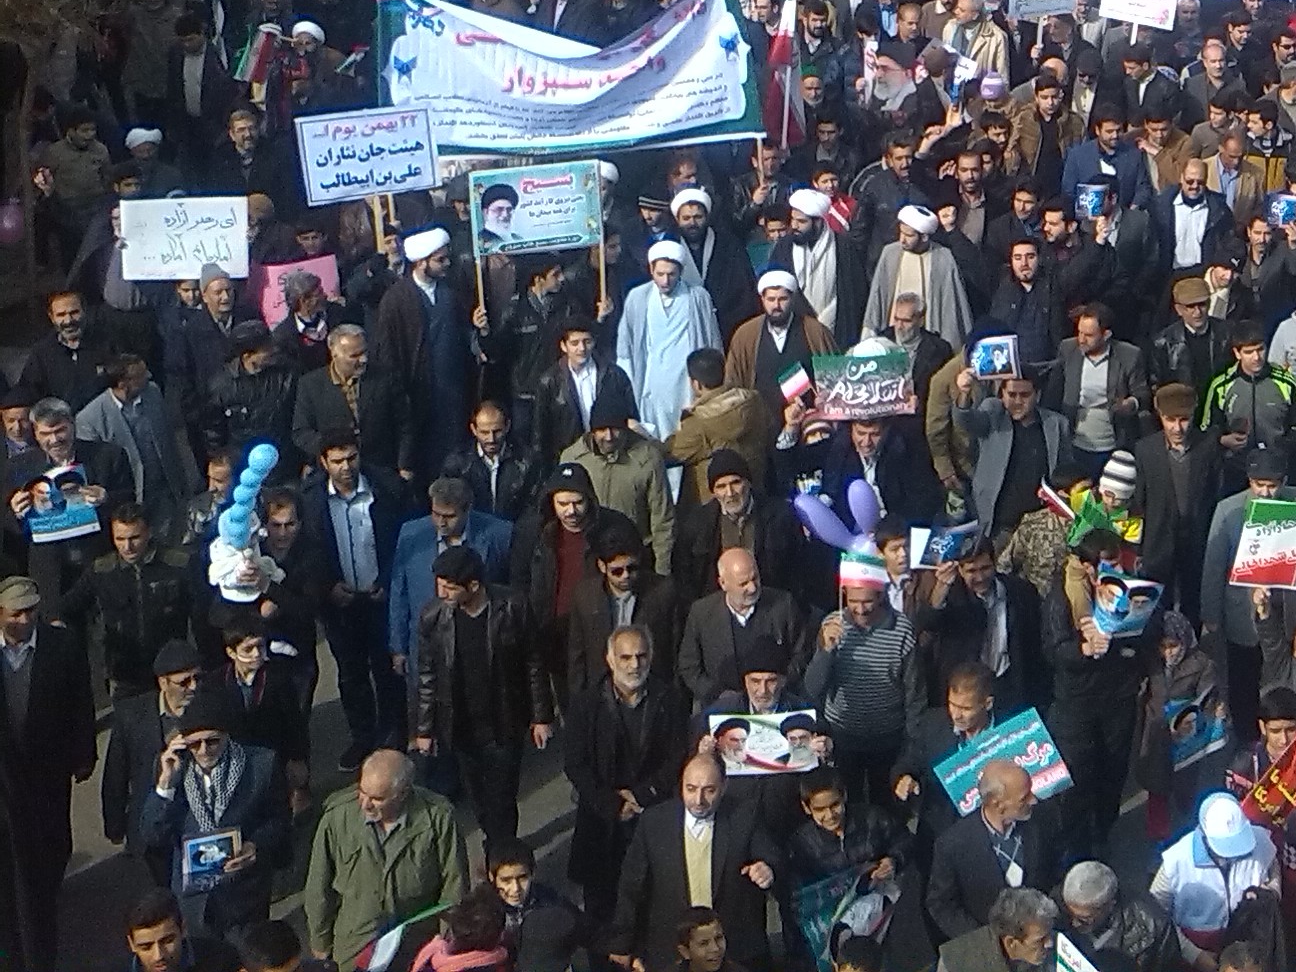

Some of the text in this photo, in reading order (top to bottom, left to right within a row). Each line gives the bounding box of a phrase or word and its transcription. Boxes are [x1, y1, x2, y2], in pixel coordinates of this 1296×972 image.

[361, 121, 398, 137] بهمن
[399, 114, 418, 128] ۲۲
[316, 145, 356, 167] نثاران
[357, 143, 387, 162] جان
[375, 171, 393, 186] بن
[393, 163, 423, 183] علی
[522, 175, 574, 194] بسیج
[846, 360, 878, 381] من
[830, 407, 843, 415] am
[1021, 742, 1055, 767] مرگ
